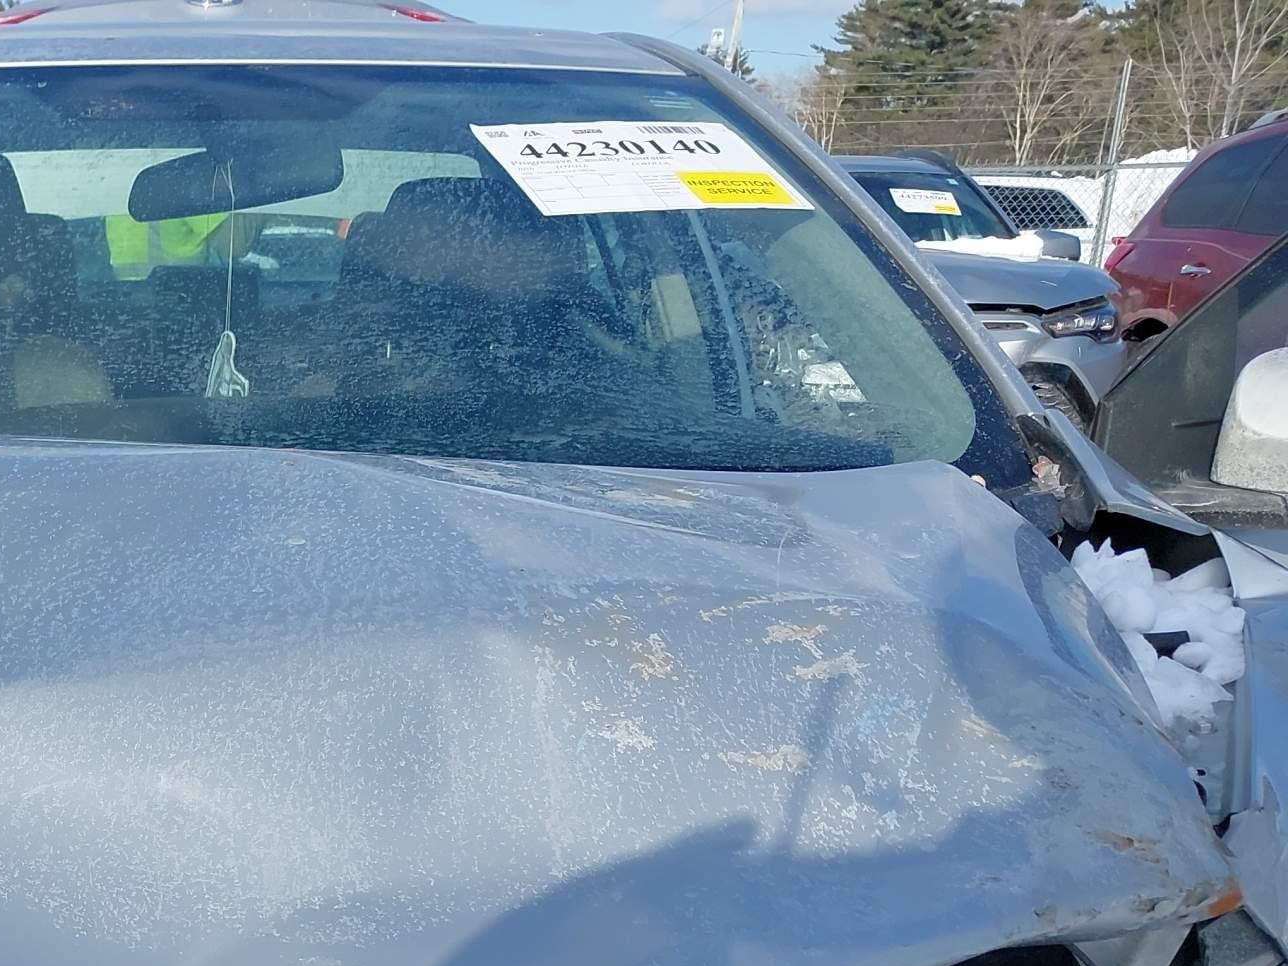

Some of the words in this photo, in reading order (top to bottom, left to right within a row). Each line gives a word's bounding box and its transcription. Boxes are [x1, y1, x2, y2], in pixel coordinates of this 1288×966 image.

[519, 139, 721, 158] 44230140
[687, 179, 776, 187] INSPECTION
[706, 187, 773, 195] SERVICE
